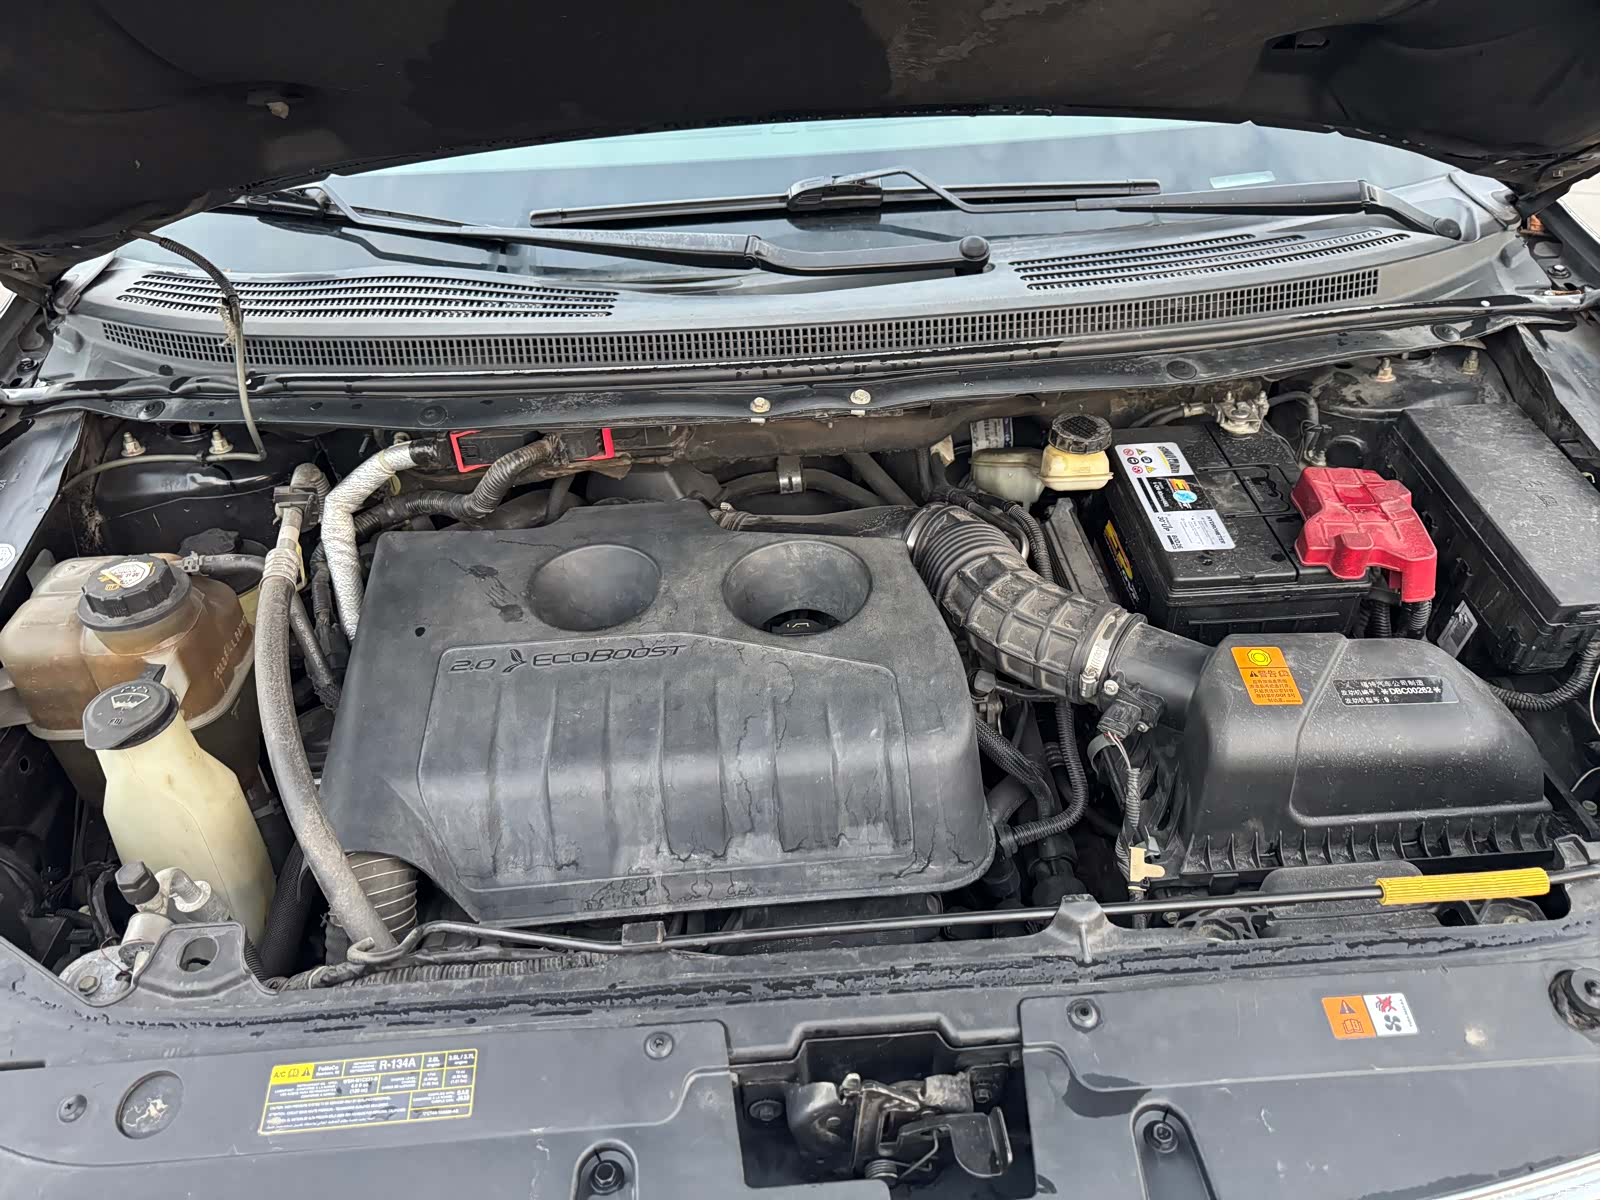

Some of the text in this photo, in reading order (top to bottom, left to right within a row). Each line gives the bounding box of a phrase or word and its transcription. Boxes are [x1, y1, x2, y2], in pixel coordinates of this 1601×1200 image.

[450, 658, 496, 672] 2.0
[379, 1057, 417, 1071] R-134A
[273, 1071, 286, 1079] A/C
